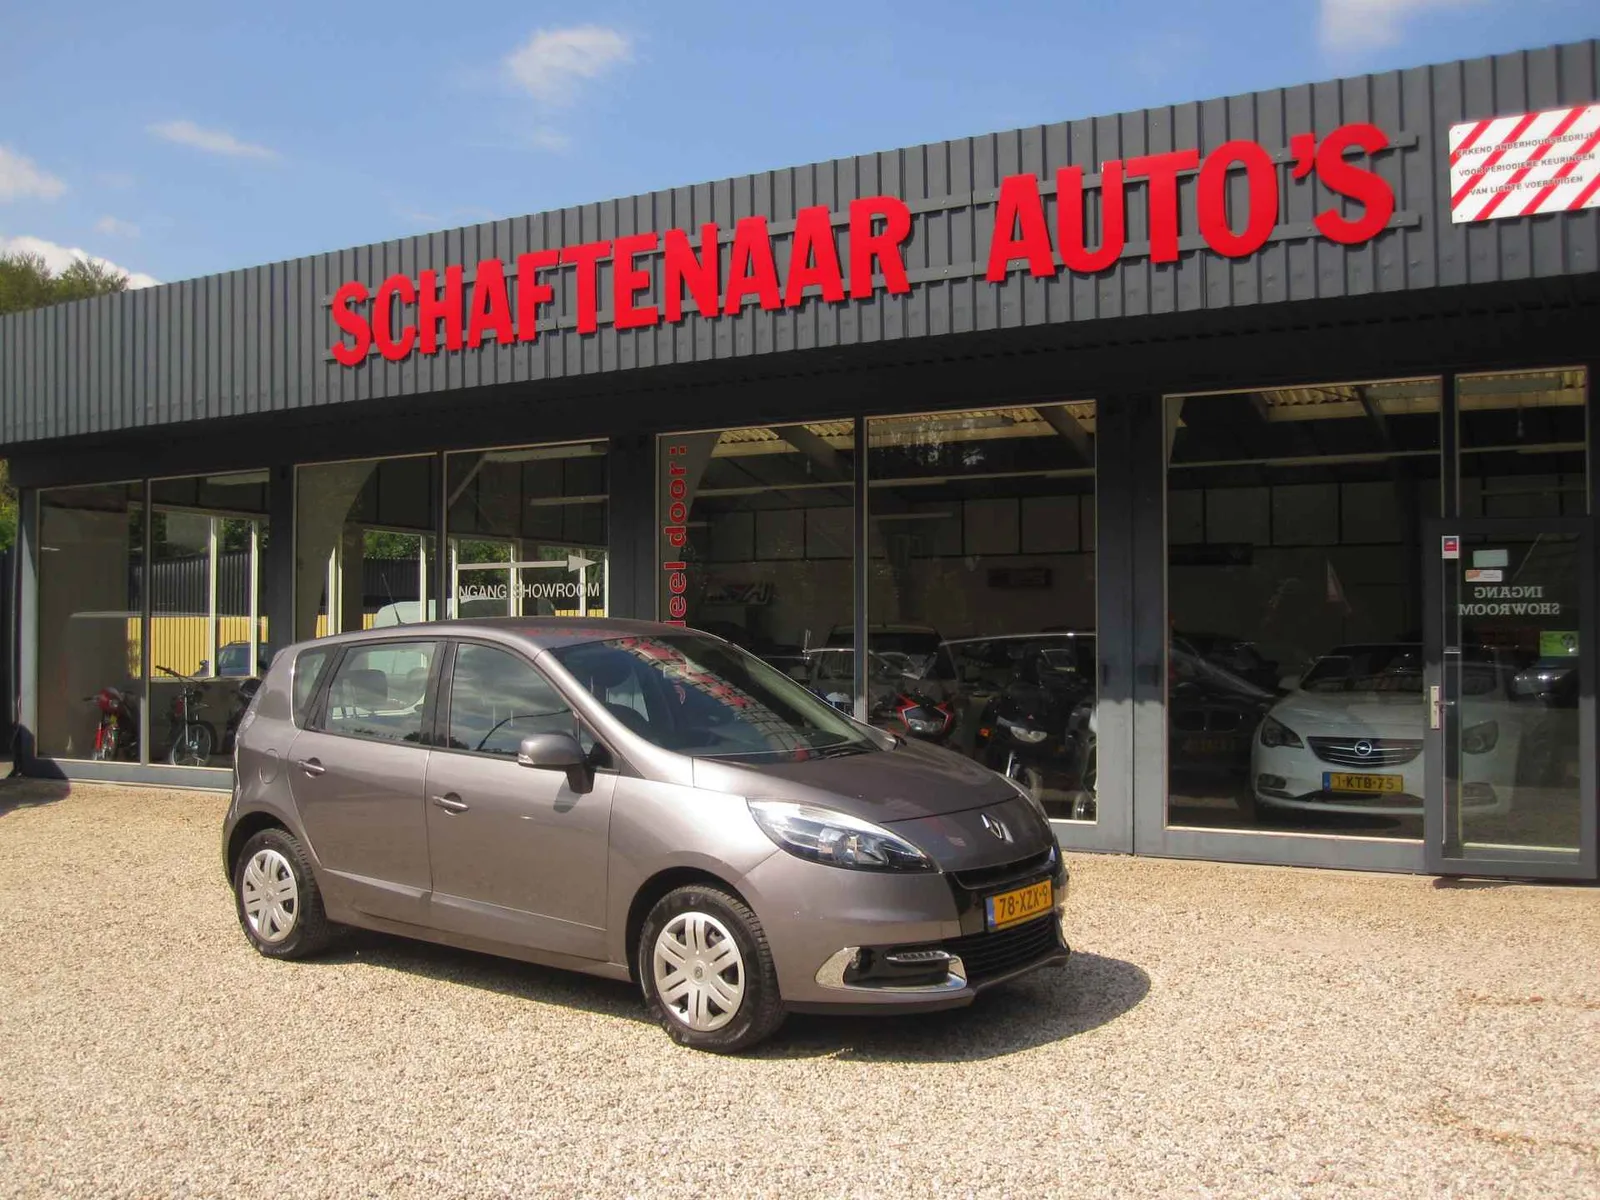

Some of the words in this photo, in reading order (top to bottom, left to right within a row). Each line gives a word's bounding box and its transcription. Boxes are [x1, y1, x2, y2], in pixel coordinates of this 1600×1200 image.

[1456, 145, 1493, 158] ERKEND
[1458, 167, 1484, 177] VOOR
[1485, 159, 1539, 174] PERIODIEKE
[1540, 152, 1596, 167] KEURINGEN
[1470, 186, 1488, 196] VAN
[1489, 182, 1522, 195] LICHTE
[1524, 175, 1583, 190] VOERTUIGEN
[331, 195, 912, 366] SCHAFTENAAR
[985, 122, 1396, 283] AUTO'S
[455, 583, 508, 600] NGANG
[512, 581, 600, 599] SHOWROOM
[664, 561, 687, 628] eel
[999, 885, 1048, 920] 78-XZX-9
